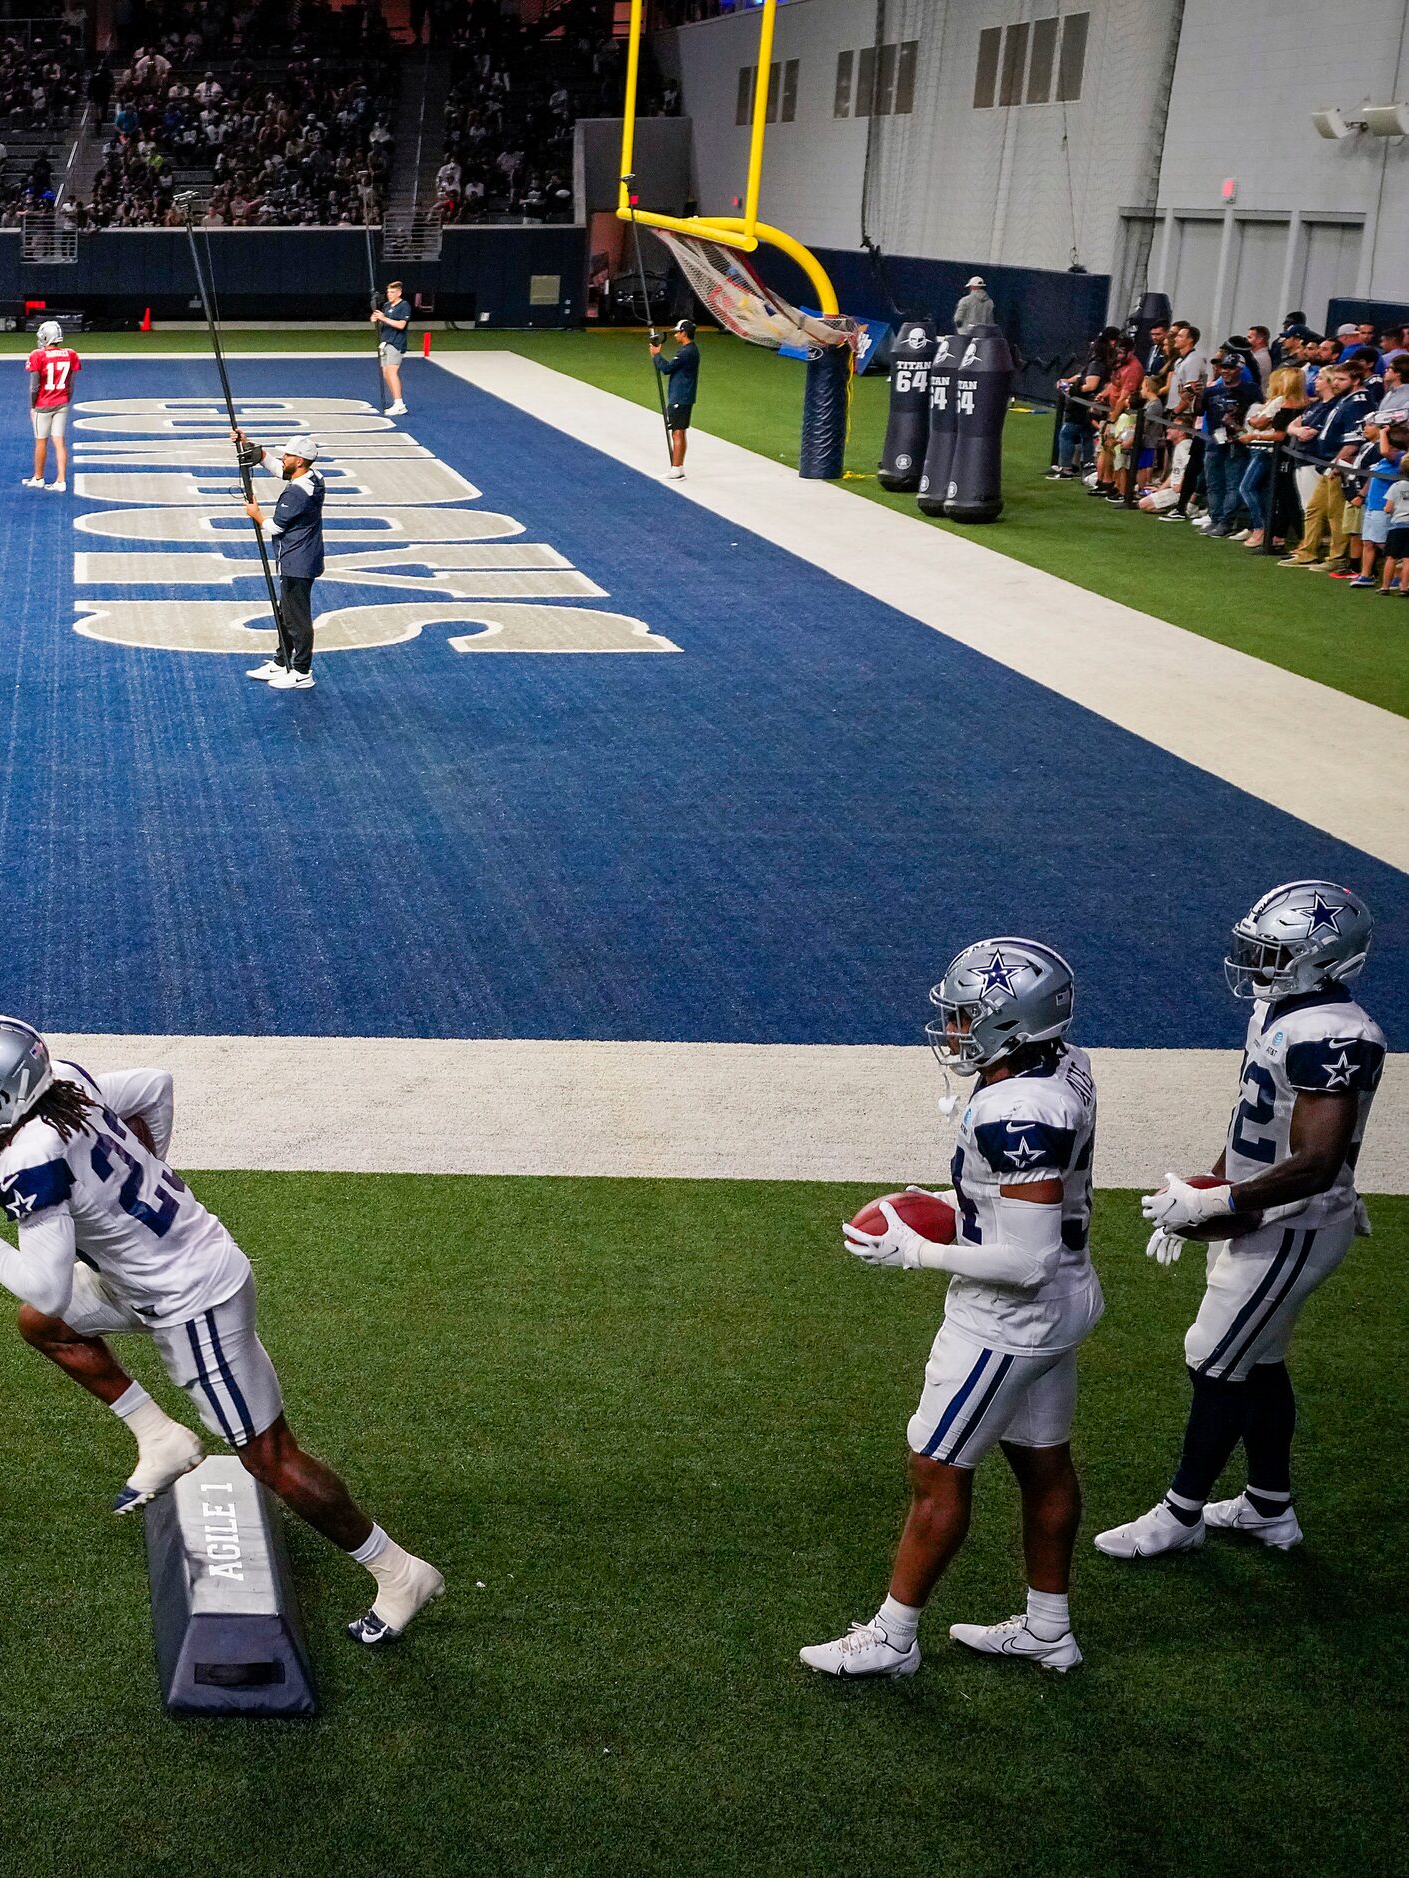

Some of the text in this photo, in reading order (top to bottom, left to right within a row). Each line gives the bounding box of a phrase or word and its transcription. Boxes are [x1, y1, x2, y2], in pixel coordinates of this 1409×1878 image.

[44, 361, 70, 390] 17
[896, 361, 931, 370] TITAN
[896, 371, 927, 392] 64
[200, 1482, 245, 1581] AGILE 1
